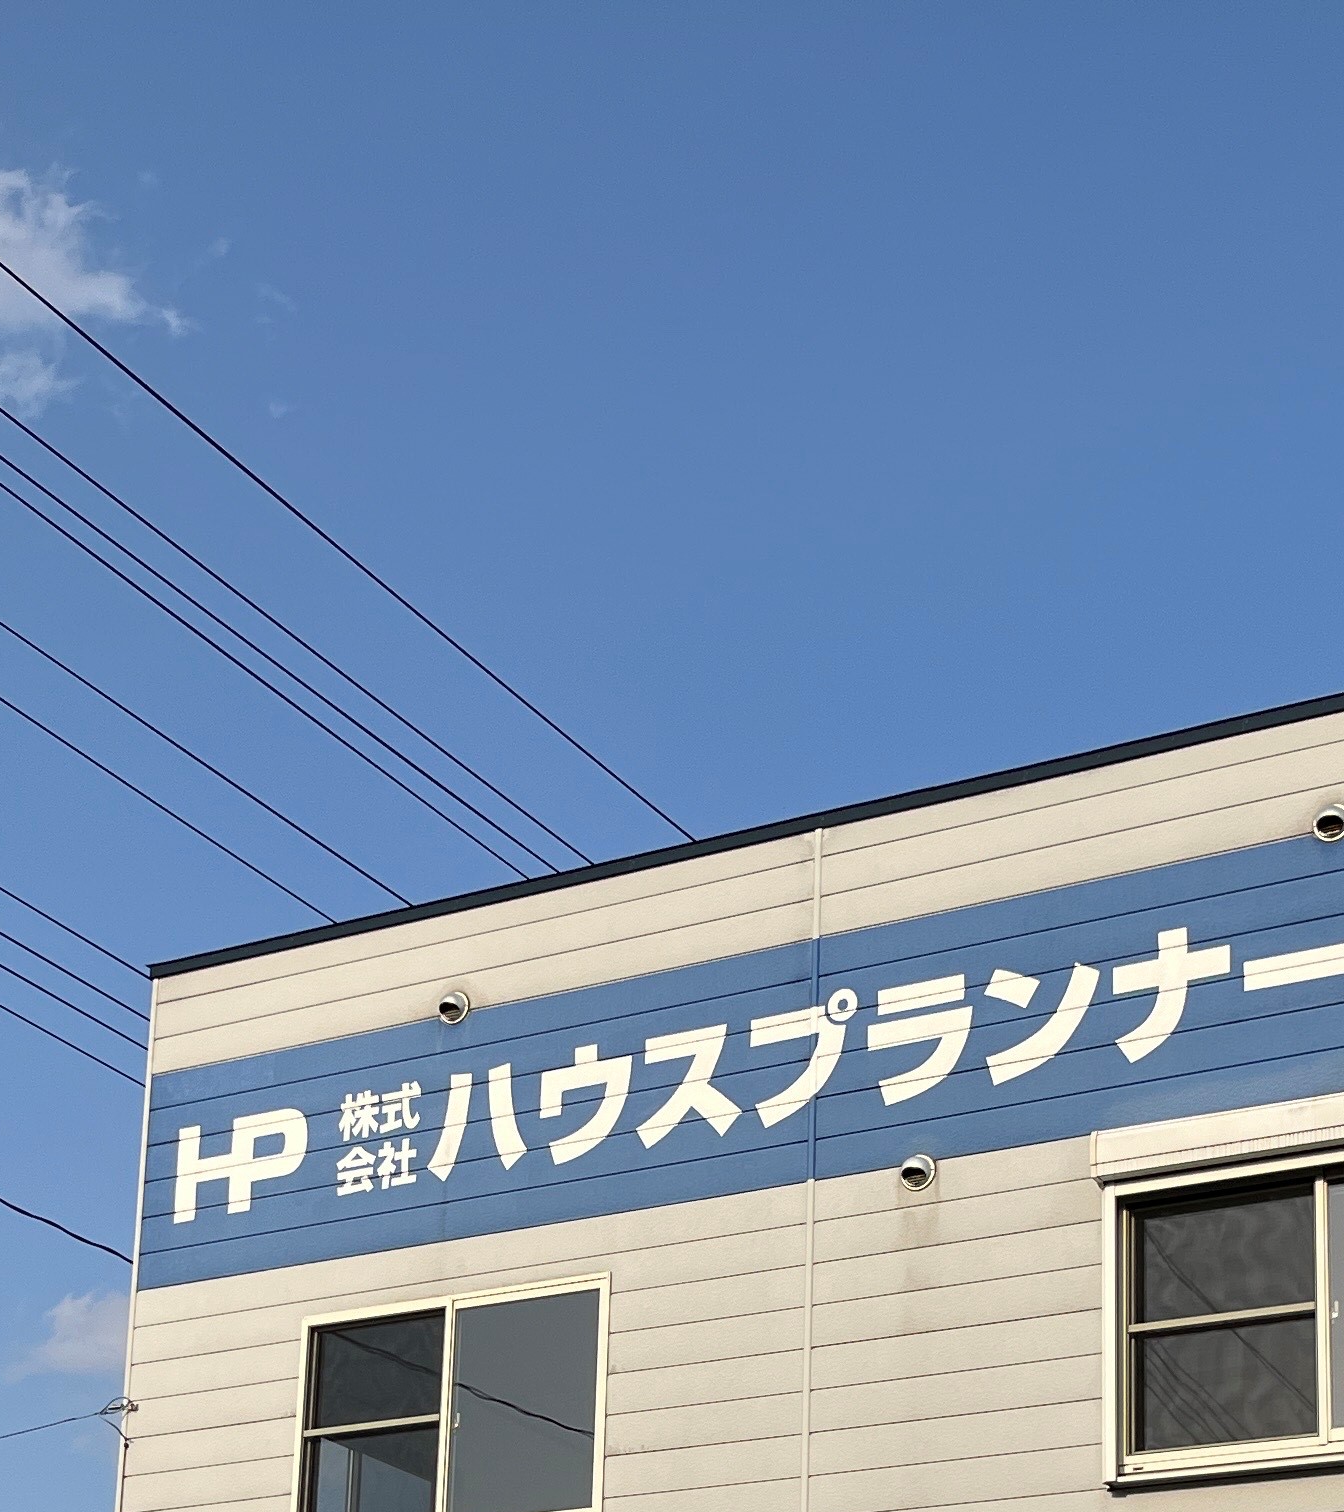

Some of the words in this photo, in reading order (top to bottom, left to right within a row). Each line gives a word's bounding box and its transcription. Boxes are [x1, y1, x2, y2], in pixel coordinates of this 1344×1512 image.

[337, 1080, 421, 1139] 株式
[173, 1107, 309, 1224] HP
[334, 1139, 420, 1198] 会社
